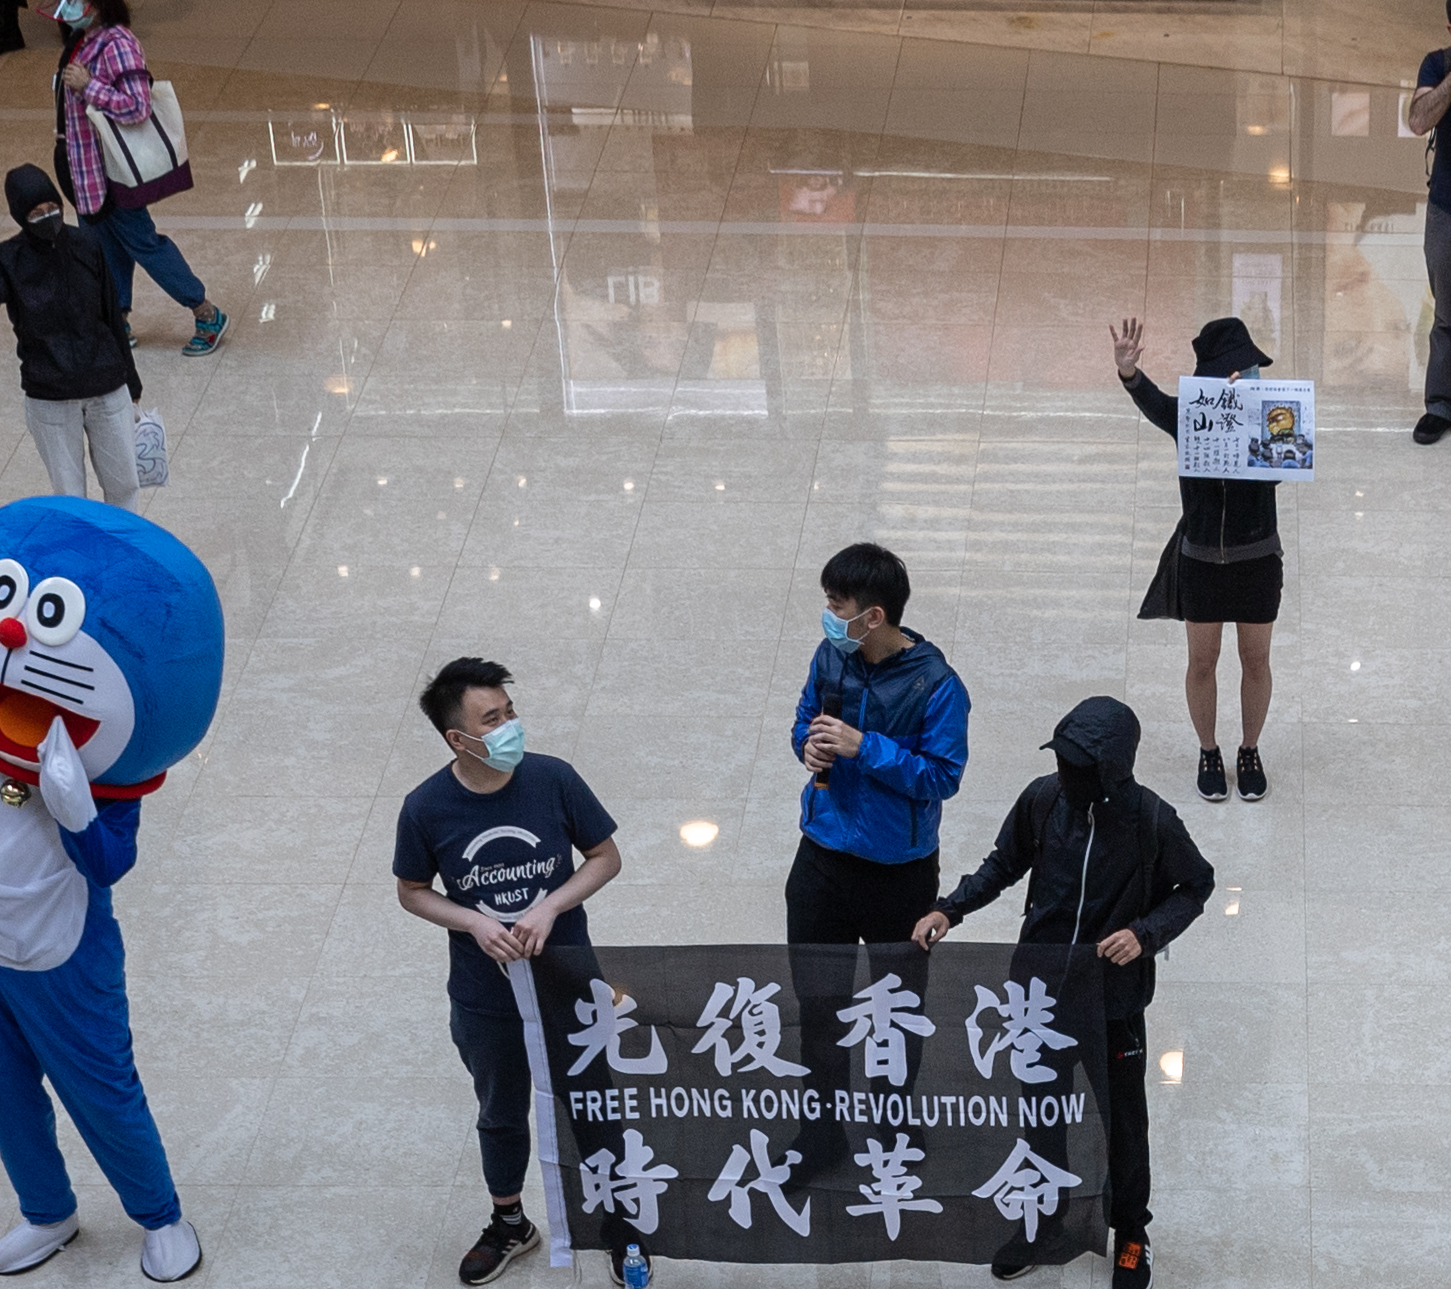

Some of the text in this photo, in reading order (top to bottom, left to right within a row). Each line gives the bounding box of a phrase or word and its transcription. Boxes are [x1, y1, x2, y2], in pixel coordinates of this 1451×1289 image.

[456, 857, 556, 891] Accounting
[494, 888, 529, 906] HKUST
[566, 972, 1078, 1087] 光復香港
[569, 1087, 641, 1122] FREE
[649, 1086, 732, 1119] HONG
[1018, 1092, 1086, 1129] NOW
[579, 1128, 1083, 1242] 時代革命
